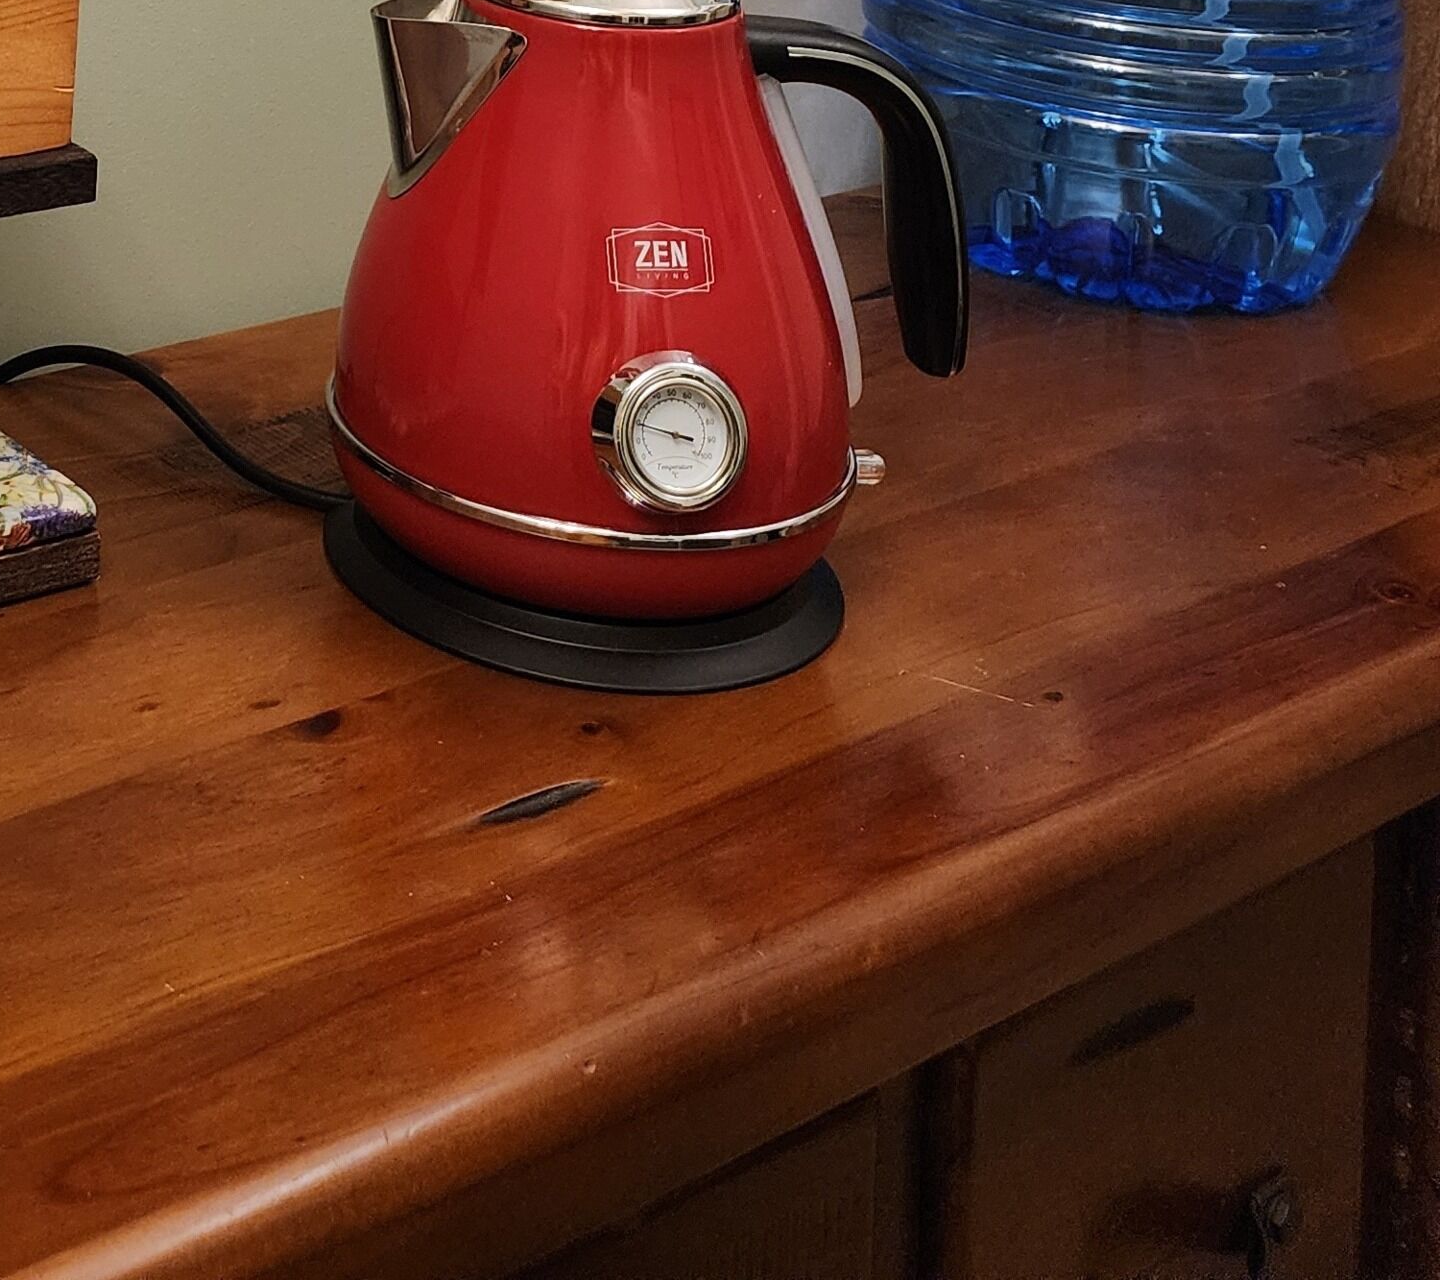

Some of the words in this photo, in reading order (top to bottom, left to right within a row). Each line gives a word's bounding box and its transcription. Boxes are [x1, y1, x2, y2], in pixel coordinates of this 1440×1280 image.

[634, 240, 688, 268] ZEN
[636, 272, 690, 280] LIVING
[667, 388, 677, 396] 50
